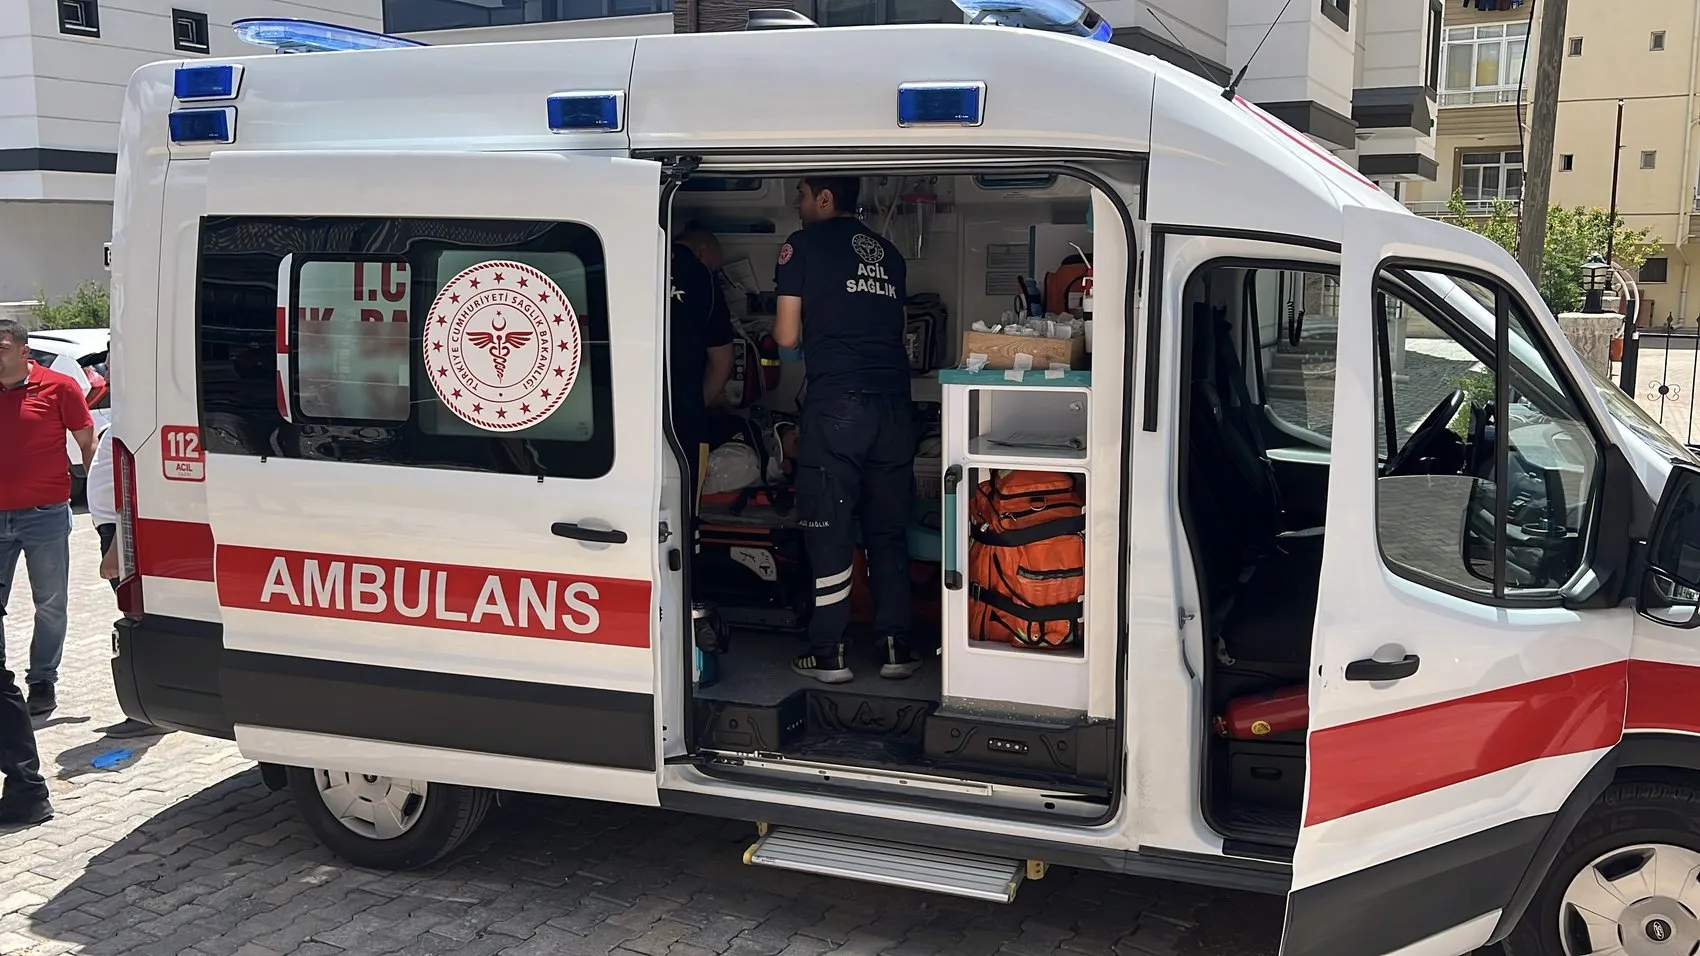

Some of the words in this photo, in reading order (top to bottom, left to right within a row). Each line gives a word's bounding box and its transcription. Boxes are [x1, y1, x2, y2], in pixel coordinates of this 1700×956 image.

[857, 263, 889, 280] ACİL
[846, 278, 897, 299] SAĞLIK
[452, 293, 508, 342] CUMHURİYETİ
[167, 431, 199, 458] 112
[260, 556, 600, 635] AMBULANS
